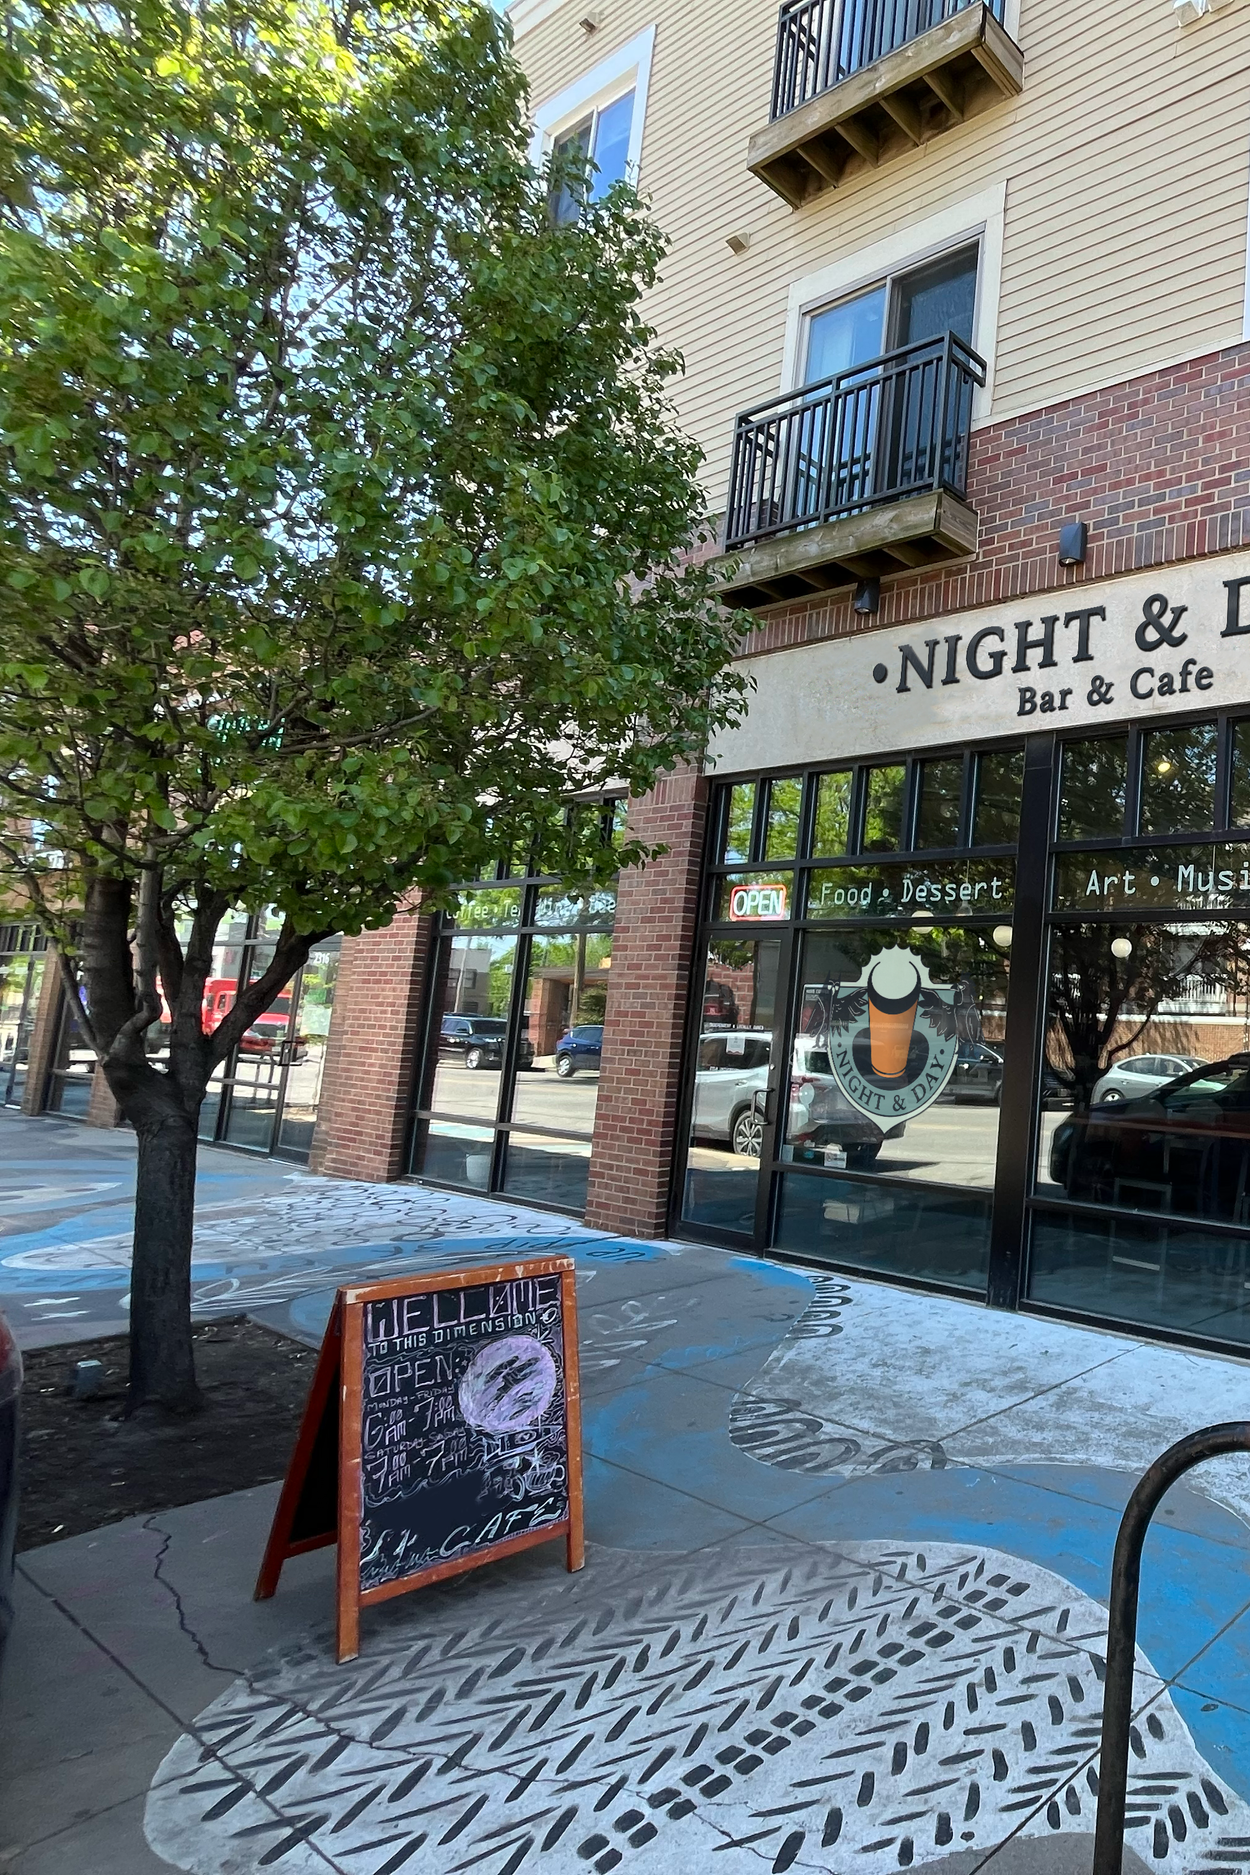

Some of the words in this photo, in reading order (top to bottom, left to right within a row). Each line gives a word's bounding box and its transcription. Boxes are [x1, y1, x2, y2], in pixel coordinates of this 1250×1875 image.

[896, 605, 1106, 693] NIGHT
[1135, 592, 1188, 652] &
[1016, 685, 1072, 716] Bar
[1087, 676, 1115, 705] &
[1129, 658, 1214, 699] Cafe
[821, 882, 872, 905] Food
[901, 875, 1003, 903] Dessert
[1086, 869, 1137, 896] Art
[733, 890, 782, 916] OPEN
[836, 1049, 885, 1110] NIGHT
[892, 1095, 907, 1112] &
[911, 1055, 945, 1104] DAY
[394, 1332, 427, 1351] THIS
[433, 1311, 537, 1343] DIMENSION
